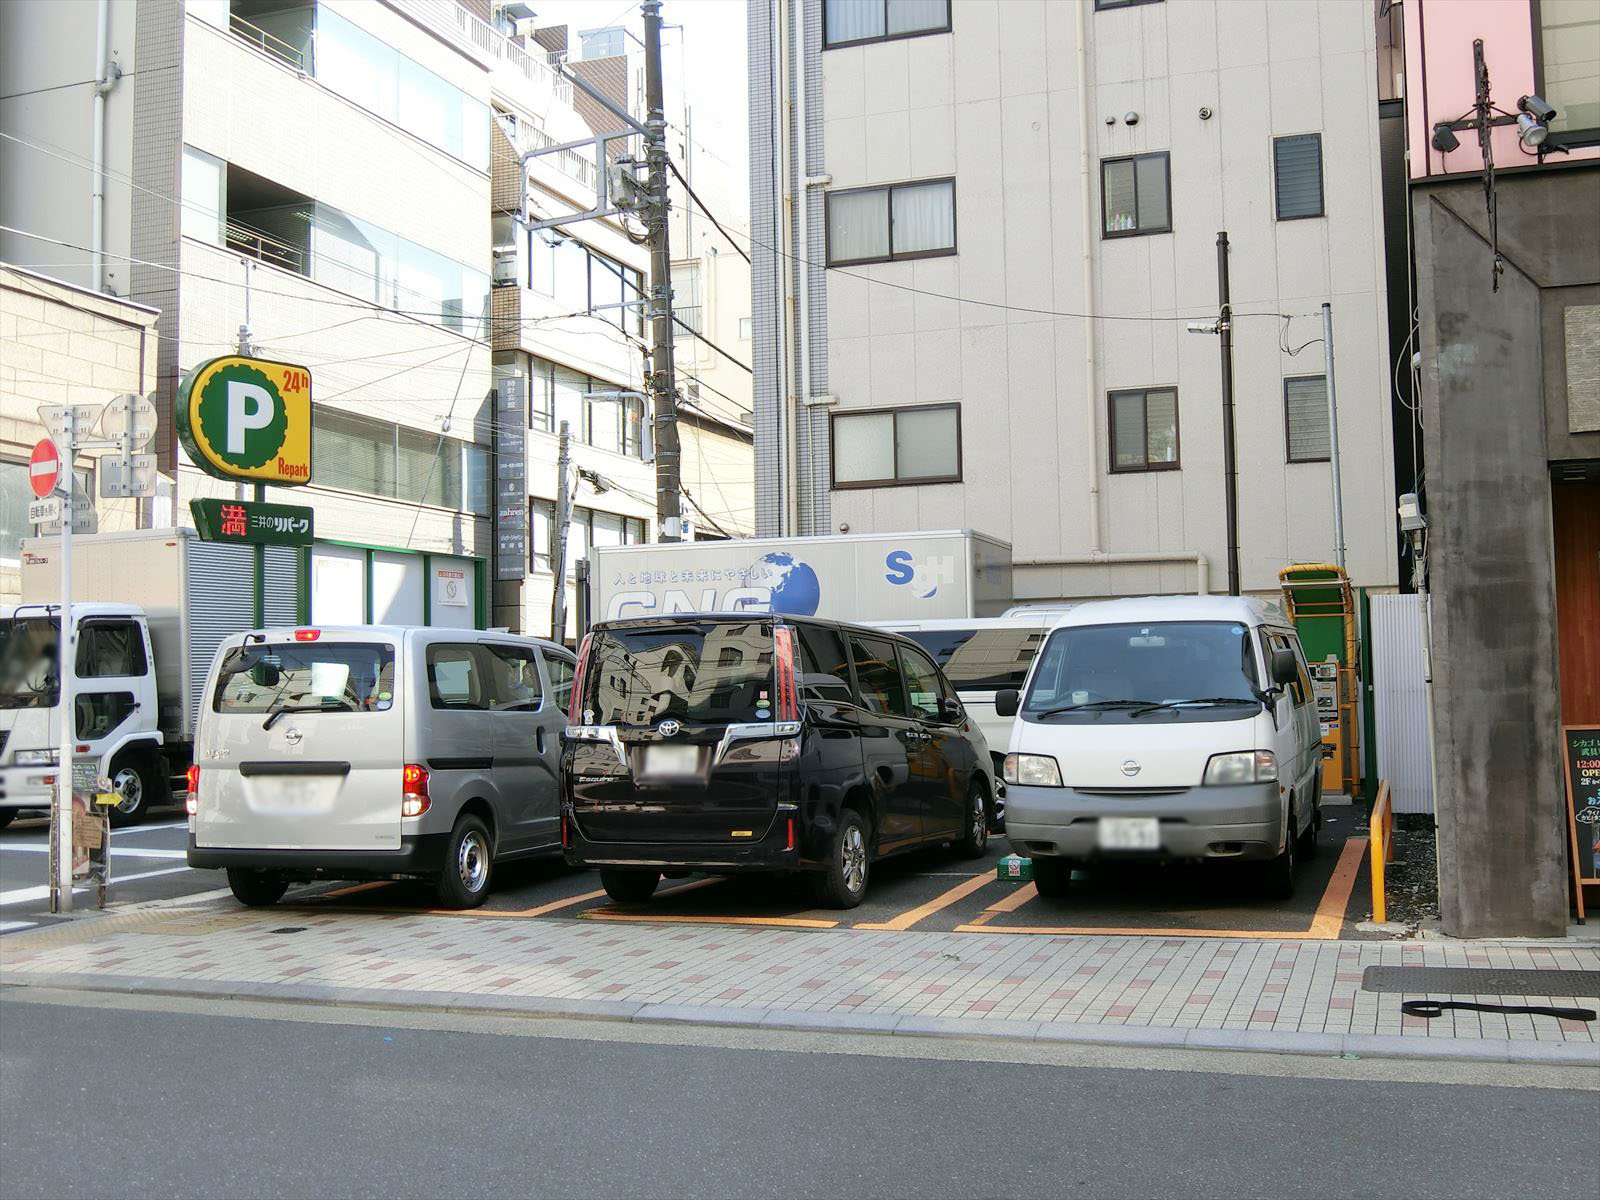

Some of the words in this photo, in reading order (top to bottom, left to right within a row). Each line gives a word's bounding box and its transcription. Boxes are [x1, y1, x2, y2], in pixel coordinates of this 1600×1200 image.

[283, 370, 309, 394] 24h
[227, 380, 274, 455] P
[277, 457, 309, 478] Repark
[30, 503, 57, 520] 自転車を除く
[220, 504, 247, 537] 満
[250, 515, 310, 534] 三井のリパーク
[613, 567, 773, 586] 人と地球と未来にやさしい
[607, 587, 771, 620] CNG
